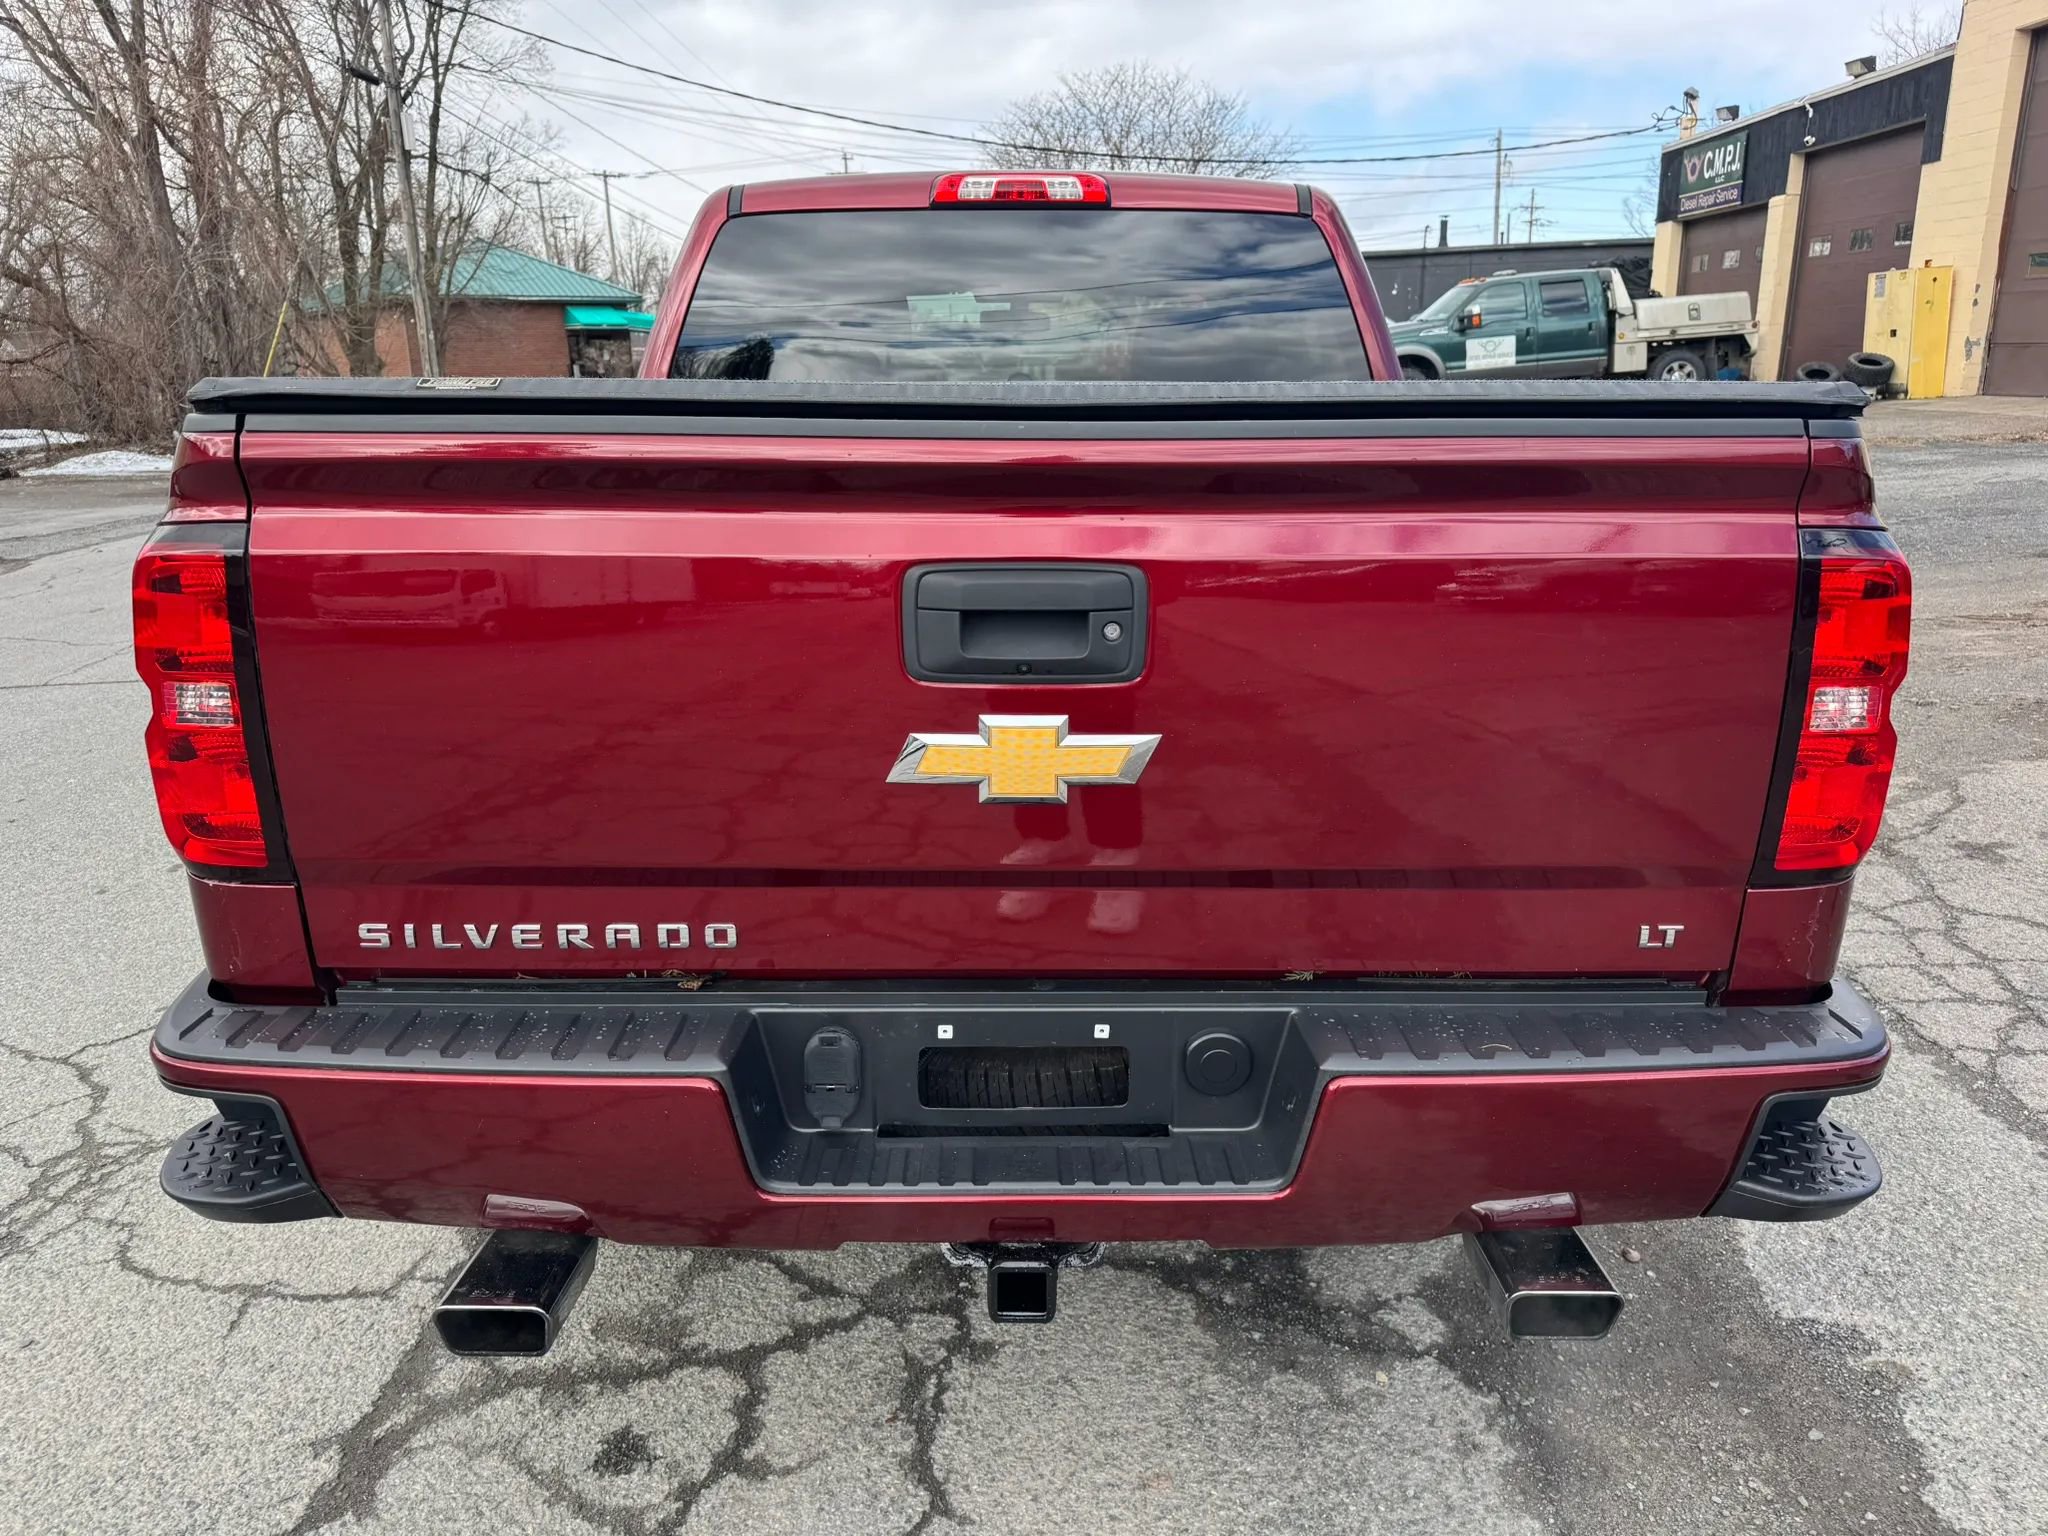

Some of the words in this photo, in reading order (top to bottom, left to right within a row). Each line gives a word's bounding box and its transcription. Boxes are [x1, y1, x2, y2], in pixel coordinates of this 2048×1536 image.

[1714, 175, 1725, 183] LLC
[1680, 197, 1698, 211] Diesel
[1698, 192, 1715, 208] Repair
[1716, 188, 1738, 203] Service
[358, 923, 738, 949] SILVERADO
[1639, 925, 1685, 948] LT
